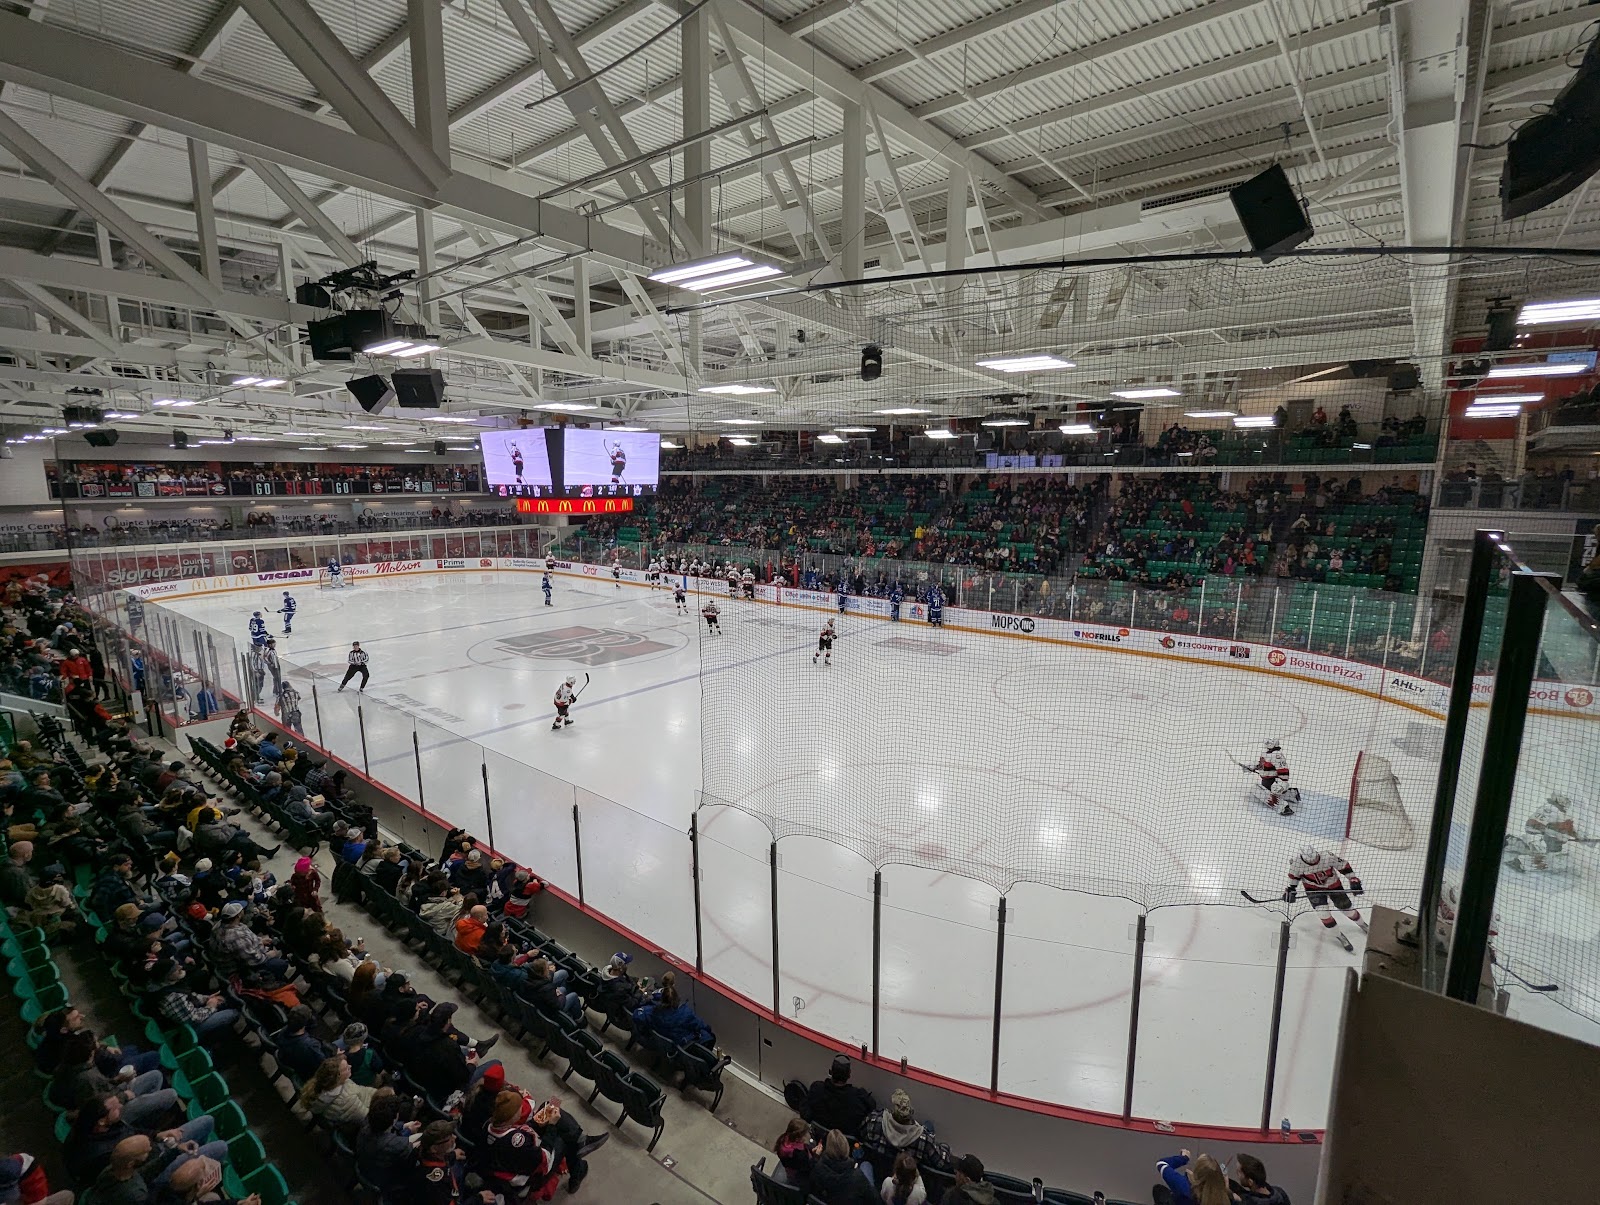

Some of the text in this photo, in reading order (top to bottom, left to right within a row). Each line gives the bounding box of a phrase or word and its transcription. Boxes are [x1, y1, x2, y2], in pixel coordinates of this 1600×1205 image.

[256, 483, 270, 495] GO
[286, 482, 322, 495] SENS
[336, 482, 349, 494] GO
[598, 486, 602, 495] 2
[625, 486, 629, 495] 1
[391, 509, 414, 518] Hearing
[374, 561, 421, 574] Molson
[257, 570, 313, 582] VISION
[151, 584, 177, 592] MACKAY
[991, 615, 1018, 631] MOPS
[1290, 656, 1332, 674] Boston
[1333, 665, 1363, 681] Pizza
